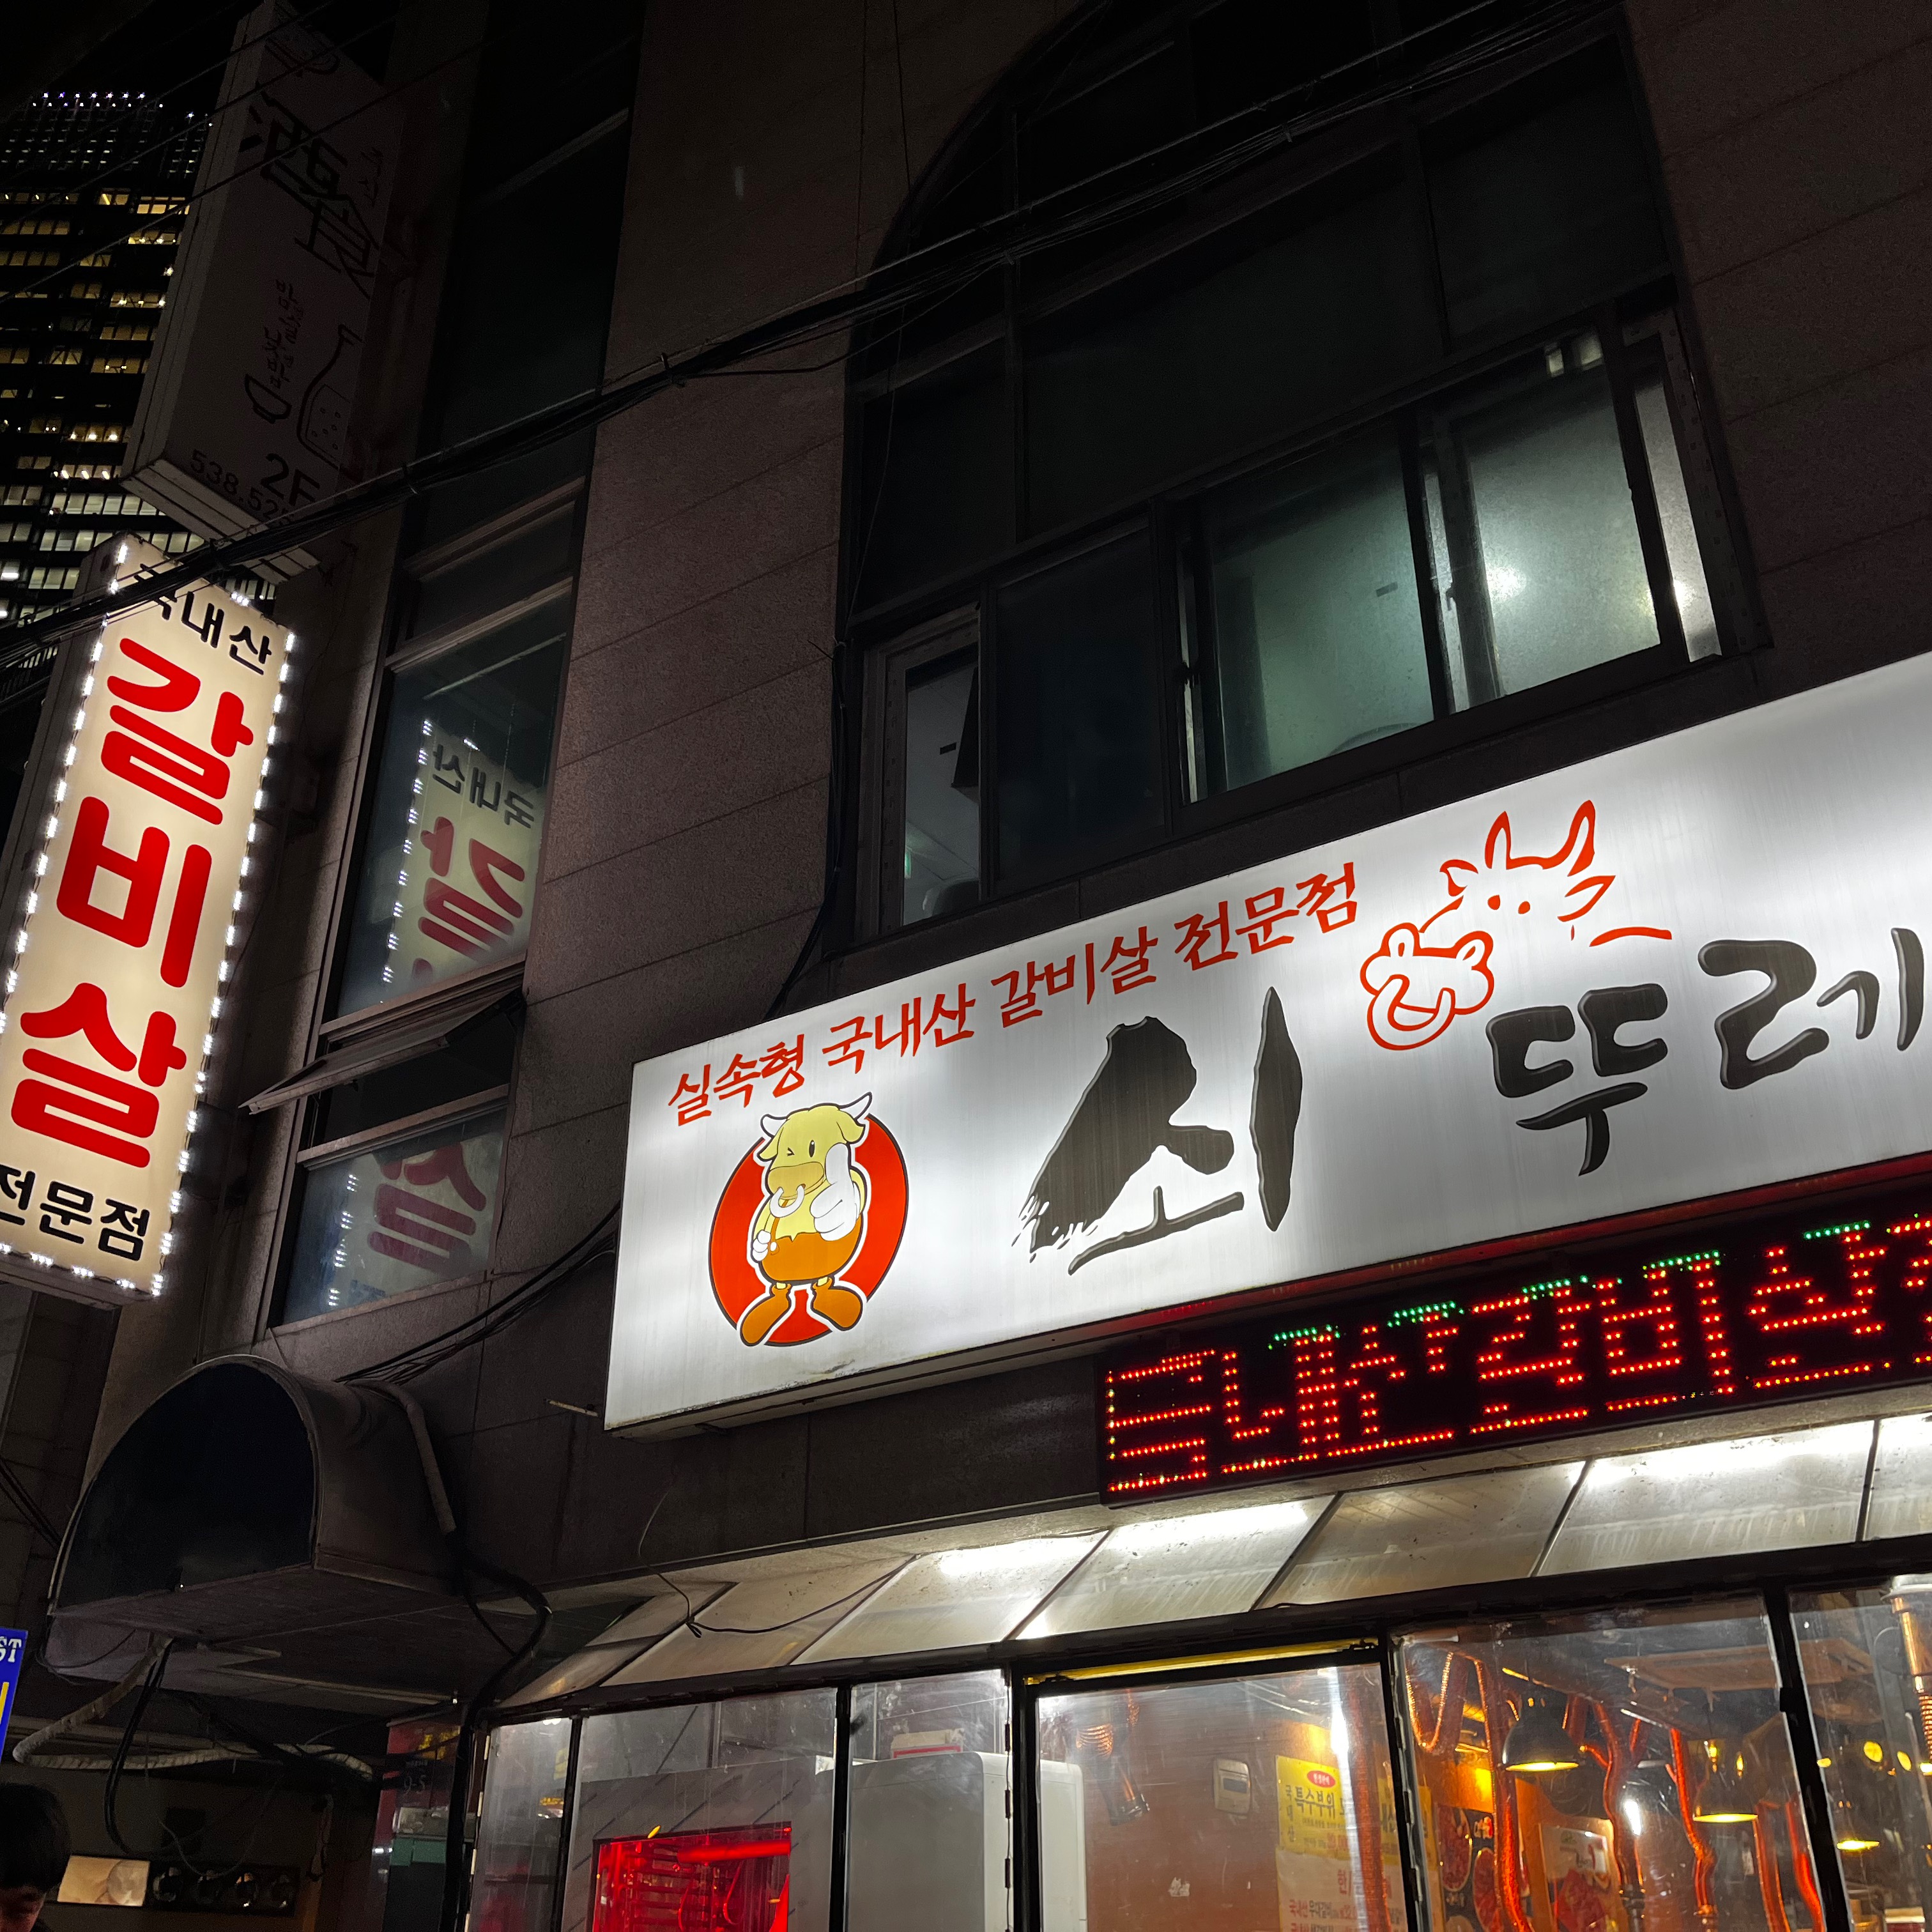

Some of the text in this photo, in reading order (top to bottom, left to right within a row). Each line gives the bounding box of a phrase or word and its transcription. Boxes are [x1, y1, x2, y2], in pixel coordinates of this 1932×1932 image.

[261, 452, 320, 507] 2F
[11, 638, 254, 1169] 갈비살
[668, 861, 1358, 1126] 실속형 국내산 갈비살 전문점
[0, 1163, 150, 1261] 전문점
[1294, 1786, 1336, 1820] 특수부위
